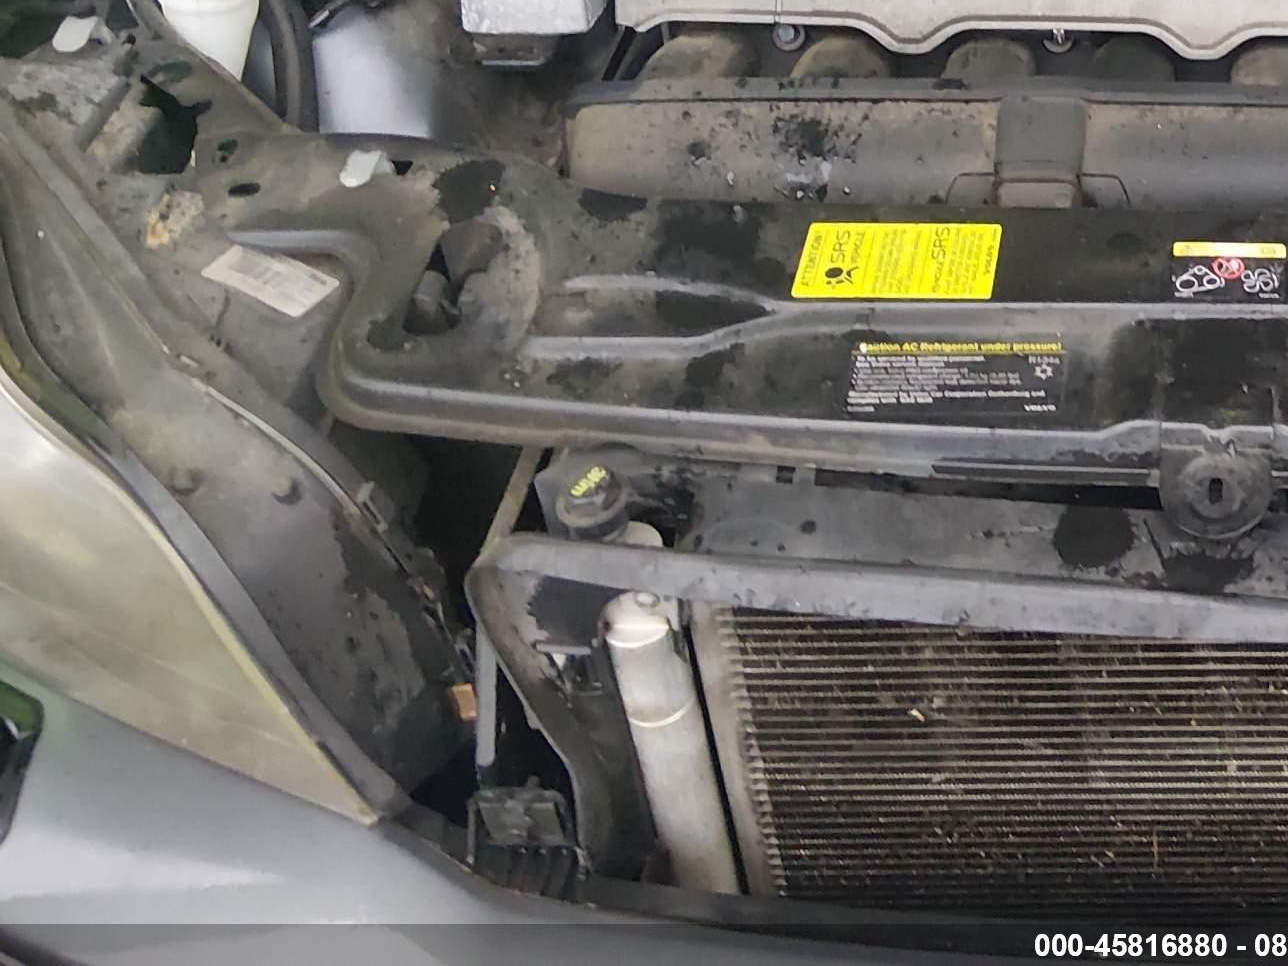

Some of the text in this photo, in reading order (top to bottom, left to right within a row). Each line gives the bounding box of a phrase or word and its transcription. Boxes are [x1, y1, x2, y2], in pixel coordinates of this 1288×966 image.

[830, 229, 851, 264] SRS
[930, 225, 951, 261] SRS
[902, 341, 919, 351] AC
